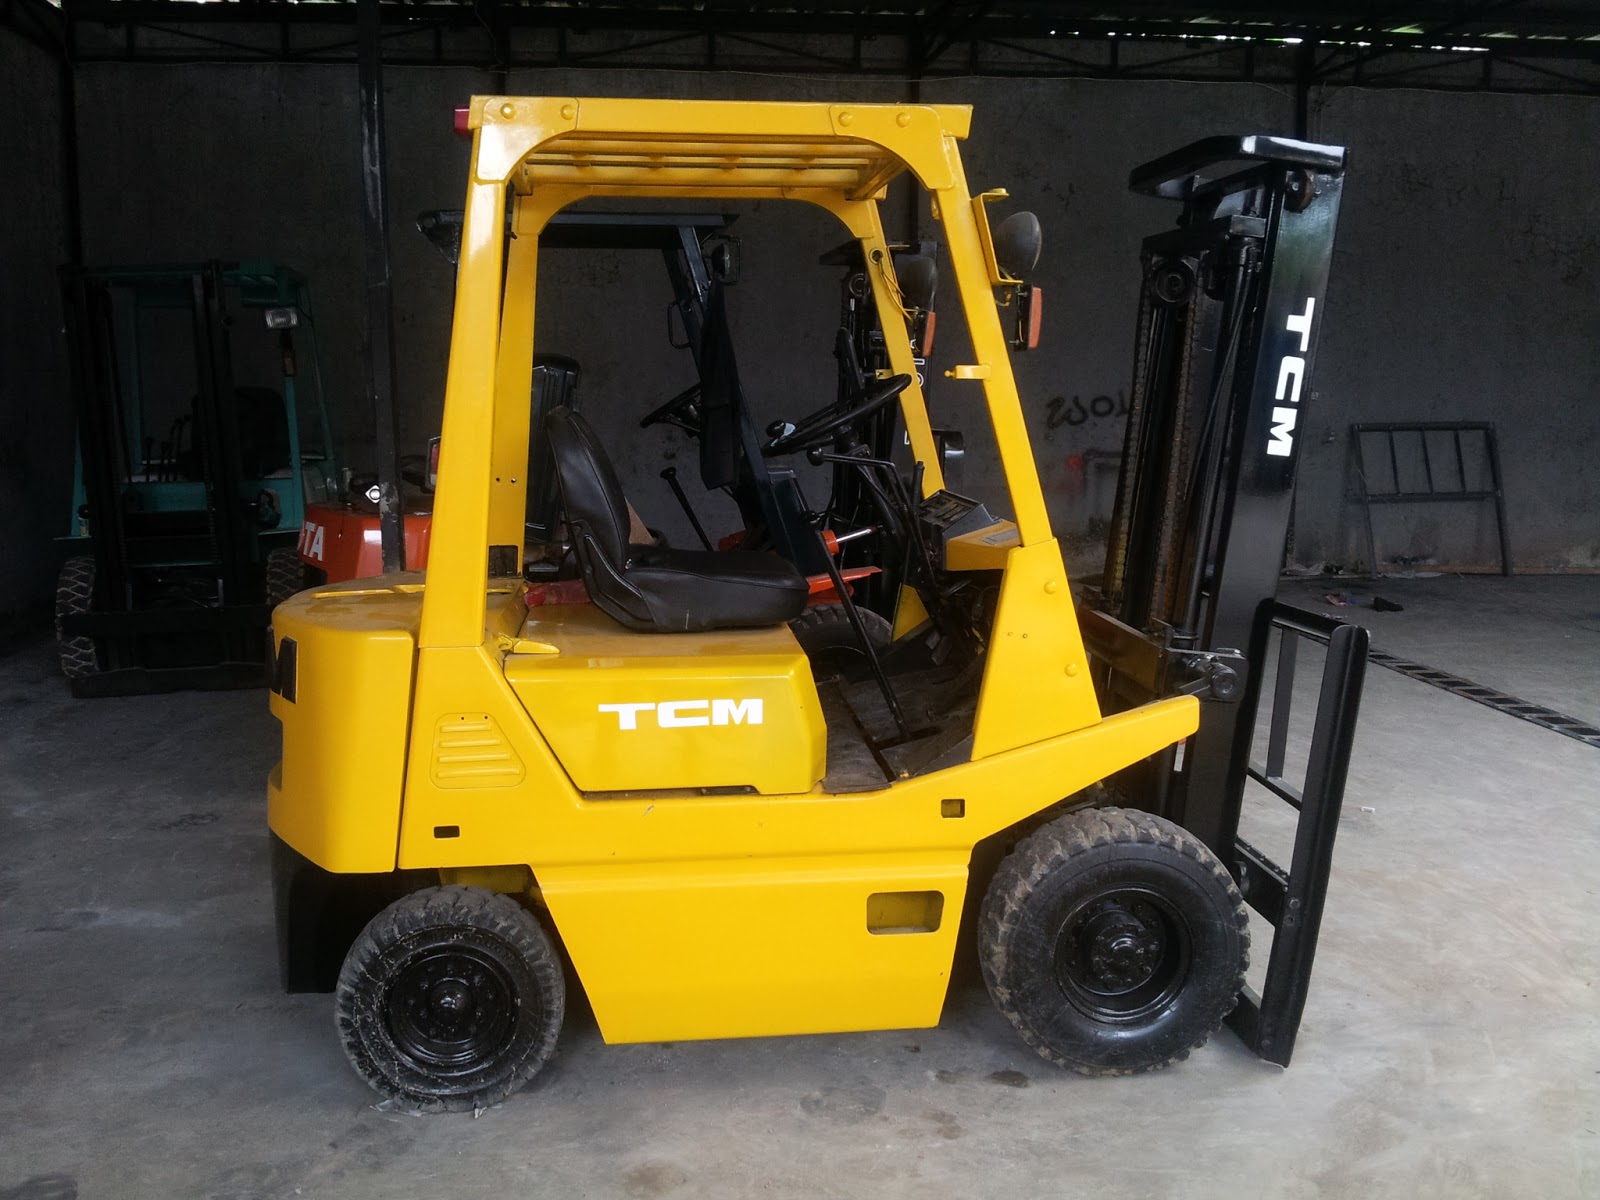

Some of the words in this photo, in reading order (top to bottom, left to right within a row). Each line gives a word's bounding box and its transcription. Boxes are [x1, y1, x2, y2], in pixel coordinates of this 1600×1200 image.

[1266, 297, 1316, 457] TCM
[297, 519, 325, 562] TA
[598, 698, 764, 730] TCM
